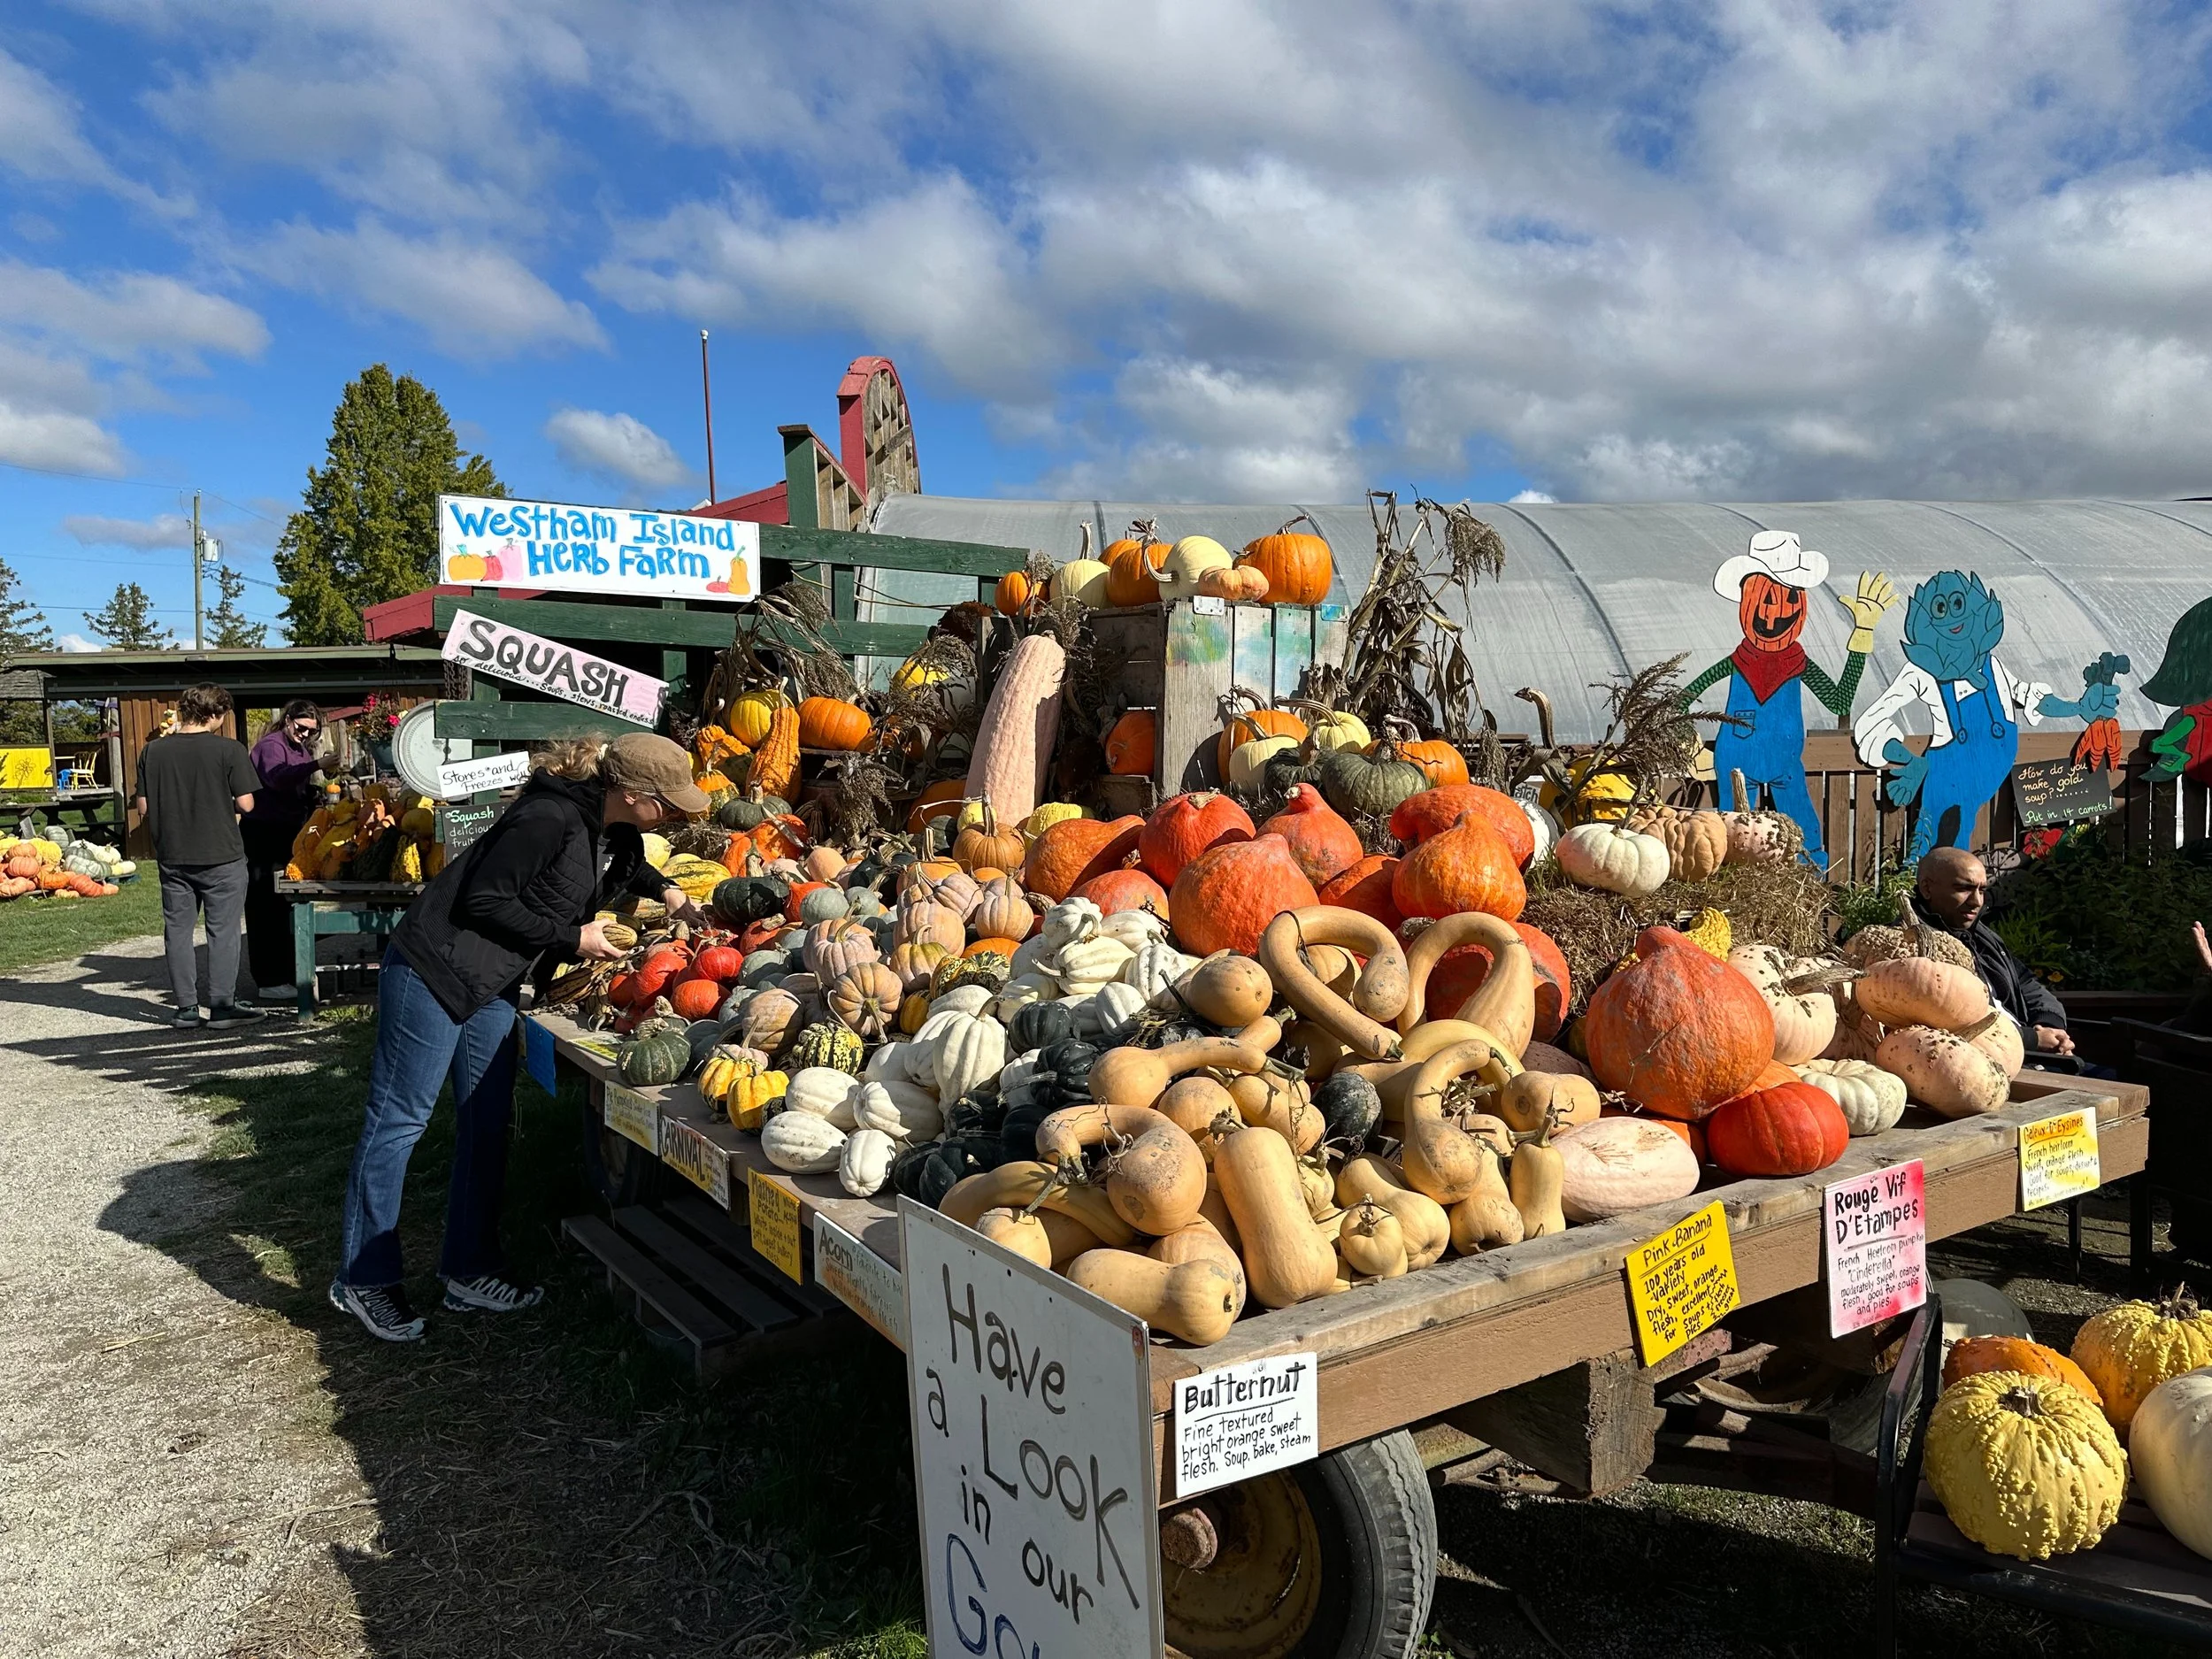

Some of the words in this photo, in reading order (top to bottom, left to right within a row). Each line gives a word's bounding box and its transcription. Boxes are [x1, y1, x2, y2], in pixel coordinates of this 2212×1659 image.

[449, 502, 617, 542] Westham
[629, 513, 735, 550] Island
[459, 619, 629, 706] SQUASH
[442, 770, 485, 785] Stores
[491, 759, 514, 776] and
[461, 777, 503, 792] Freezes
[2018, 766, 2045, 780] How
[2049, 764, 2063, 775] do
[2067, 763, 2088, 776] you
[2023, 779, 2049, 791] make
[450, 805, 494, 828] Squash
[2024, 810, 2043, 824] Put
[2047, 810, 2058, 819] in
[2063, 808, 2074, 818] 14
[2078, 795, 2112, 815] carrots!
[661, 1116, 705, 1181] CARNIVAL
[2027, 1145, 2047, 1161] French
[1834, 1185, 1878, 1217] Rouge
[1886, 1171, 1907, 1199] Vif
[1642, 1238, 1671, 1268] Pink
[1674, 1214, 1712, 1248] Banana
[1836, 1198, 1919, 1245] D'Etampes
[818, 1225, 853, 1271] Acorn
[1838, 1253, 1860, 1271] French
[1645, 1274, 1660, 1294] 100
[1663, 1256, 1686, 1282] years
[1691, 1244, 1705, 1261] old
[1652, 1271, 1685, 1302] variety
[1840, 1280, 1874, 1298] moderately
[1900, 1264, 1920, 1279] orange
[1647, 1304, 1666, 1323] Dry,
[1667, 1283, 1694, 1309] sweet,
[1694, 1264, 1718, 1288] orange
[1681, 1284, 1712, 1315] excellent
[1856, 1303, 1870, 1315] and
[1868, 1286, 1884, 1303] good
[1886, 1284, 1895, 1294] for
[1897, 1277, 1919, 1291] soups
[942, 1263, 1066, 1415] Have
[1664, 1328, 1677, 1342] for
[1683, 1306, 1705, 1329] soups
[926, 1366, 949, 1438] a
[1185, 1362, 1307, 1415] Butternut
[1182, 1434, 1225, 1463] bright
[1226, 1428, 1265, 1448] orange
[1271, 1411, 1302, 1437] sweet
[1184, 1424, 1213, 1442] Fine
[1219, 1407, 1273, 1434] textured
[1182, 1458, 1219, 1482] flesh.
[1253, 1441, 1278, 1459] bake,
[1280, 1432, 1311, 1449] steam
[960, 1464, 992, 1545] in
[1022, 1537, 1094, 1624] our
